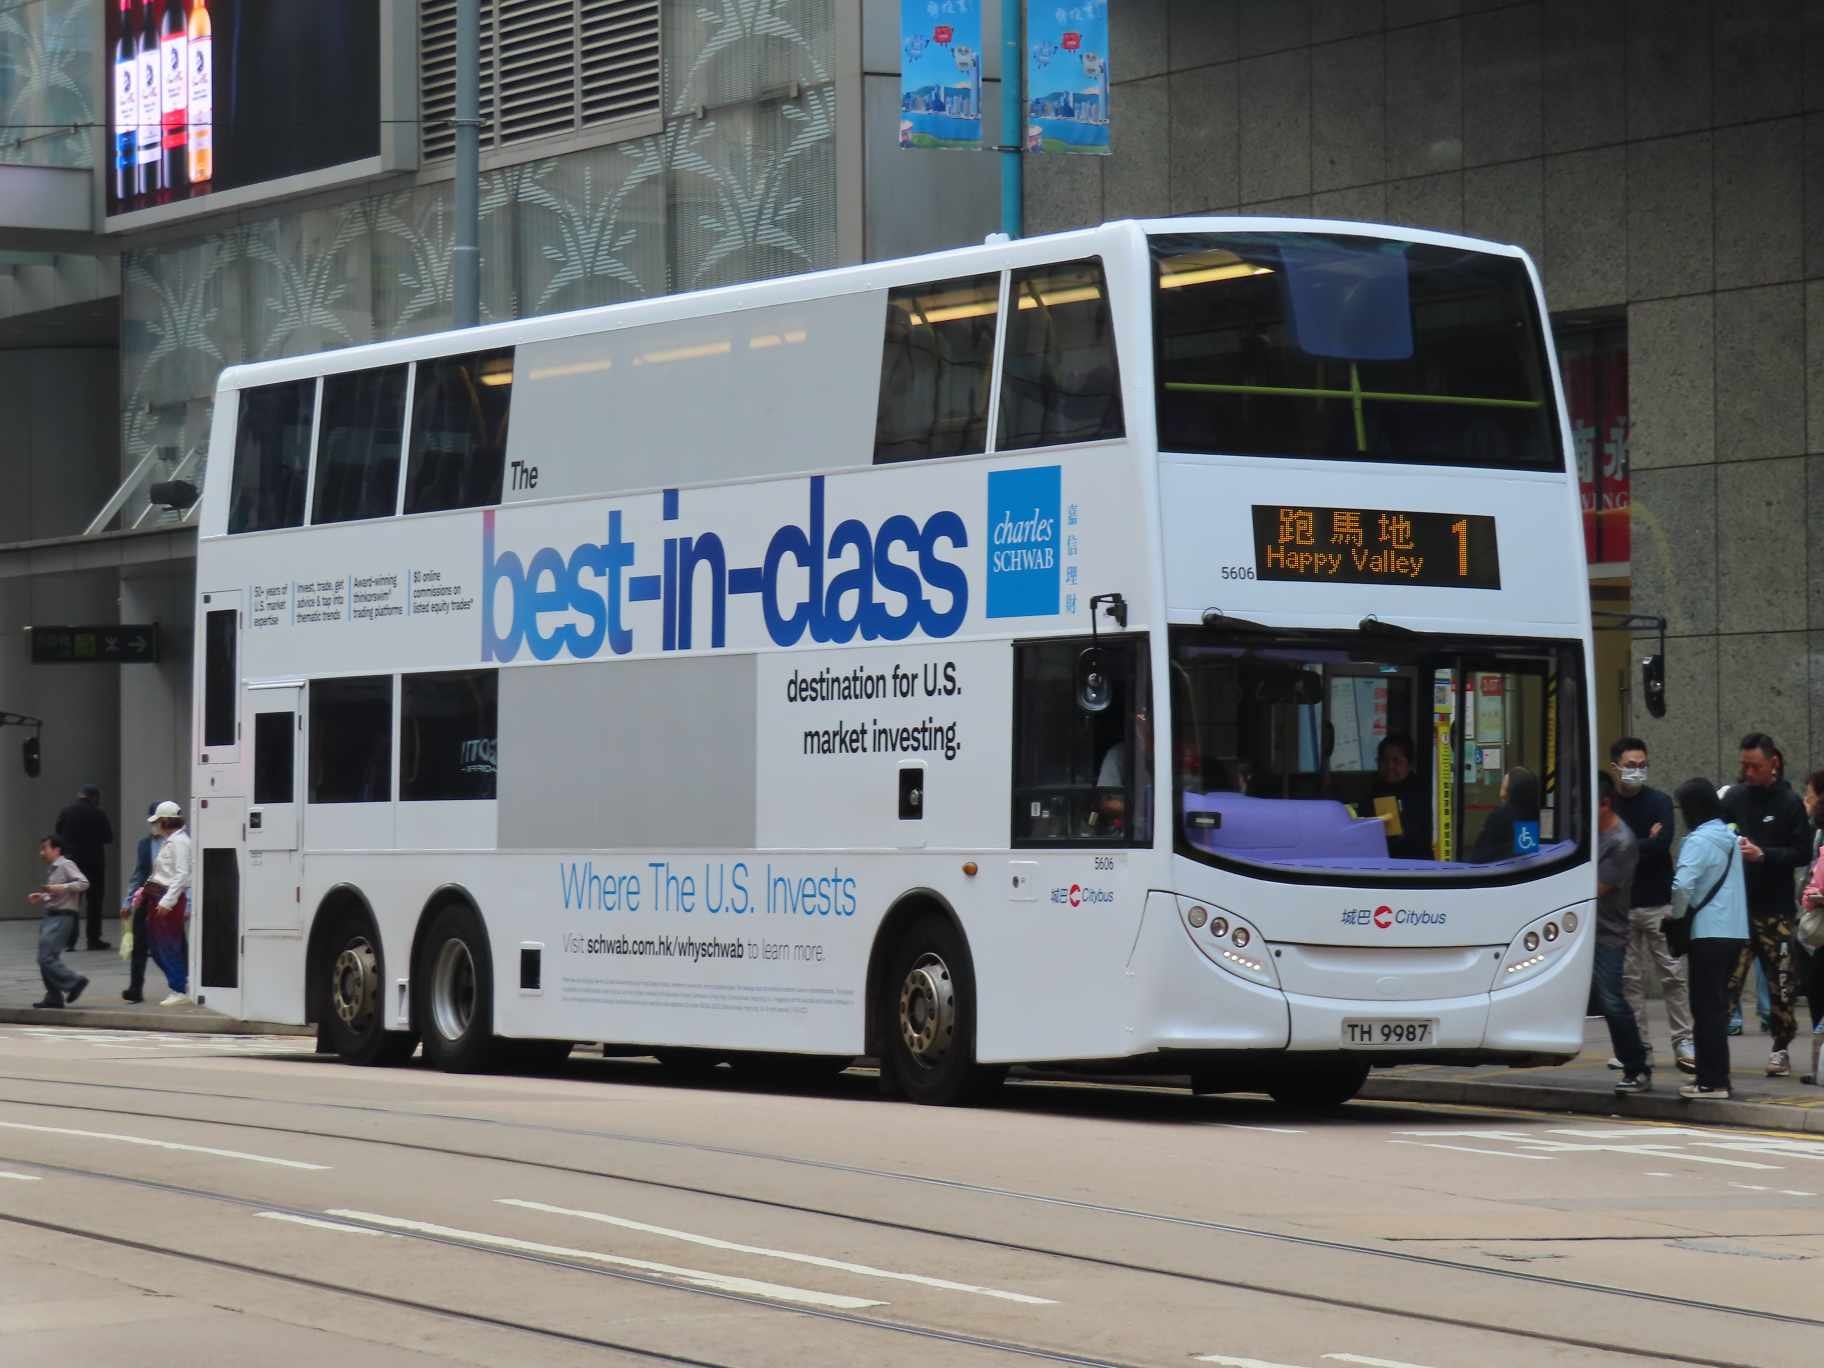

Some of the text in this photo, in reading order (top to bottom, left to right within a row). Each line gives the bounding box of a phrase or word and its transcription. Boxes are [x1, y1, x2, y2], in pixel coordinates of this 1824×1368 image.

[511, 460, 538, 490] The
[993, 508, 1054, 545] charles
[1278, 508, 1415, 550] 跑馬地
[993, 547, 1054, 573] SCHWAB
[1267, 544, 1424, 578] Happy Valley
[1451, 519, 1470, 576] 1
[481, 475, 969, 663] best-in-class
[1221, 566, 1255, 580] 5606
[787, 661, 962, 702] destination for U.S.
[803, 716, 961, 760] market investing.
[1094, 856, 1114, 871] 5606
[560, 862, 857, 916] Where The U.S. Invests
[1082, 887, 1114, 904] Citybus
[1342, 908, 1371, 926] 城巴
[1395, 908, 1447, 927] Citybus
[562, 932, 827, 963] Visit schwab.com.hk/whyschwab to learn more.
[1347, 1023, 1428, 1042] TH 9987
